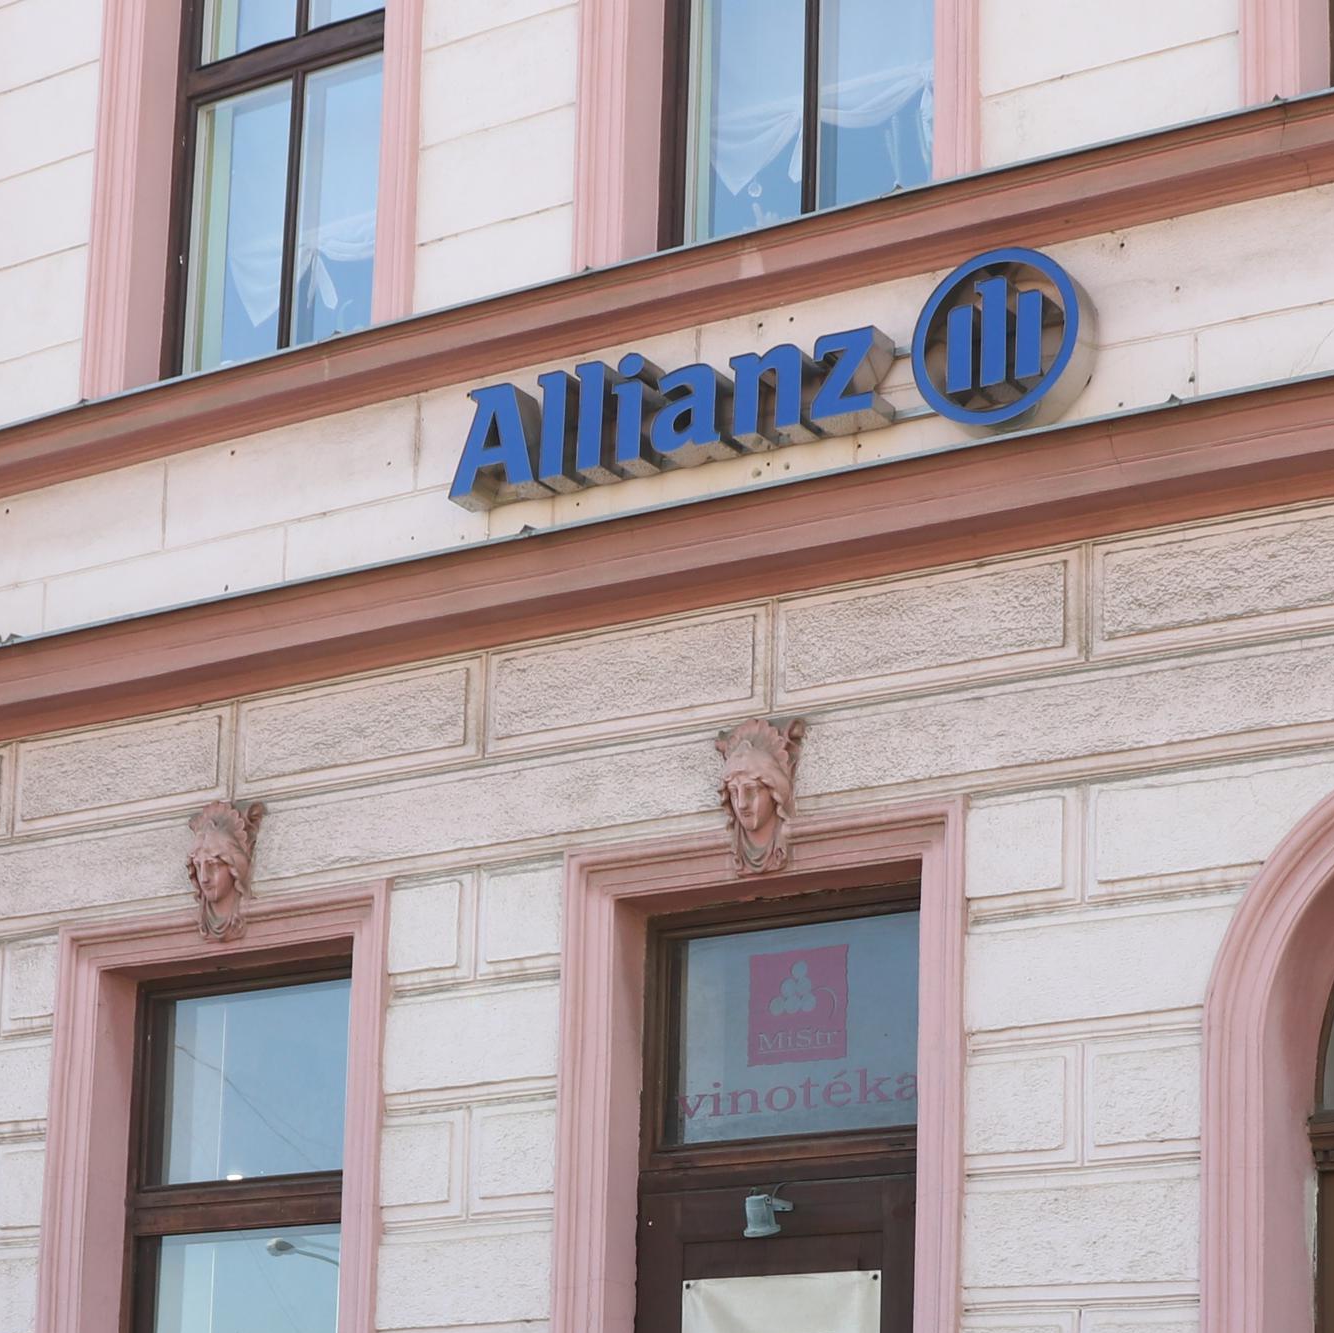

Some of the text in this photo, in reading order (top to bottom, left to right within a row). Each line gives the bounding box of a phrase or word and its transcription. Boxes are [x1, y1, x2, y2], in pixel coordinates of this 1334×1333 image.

[449, 325, 879, 506] Allianz
[757, 1026, 838, 1051] MiStr
[678, 1068, 918, 1120] vinotéka
